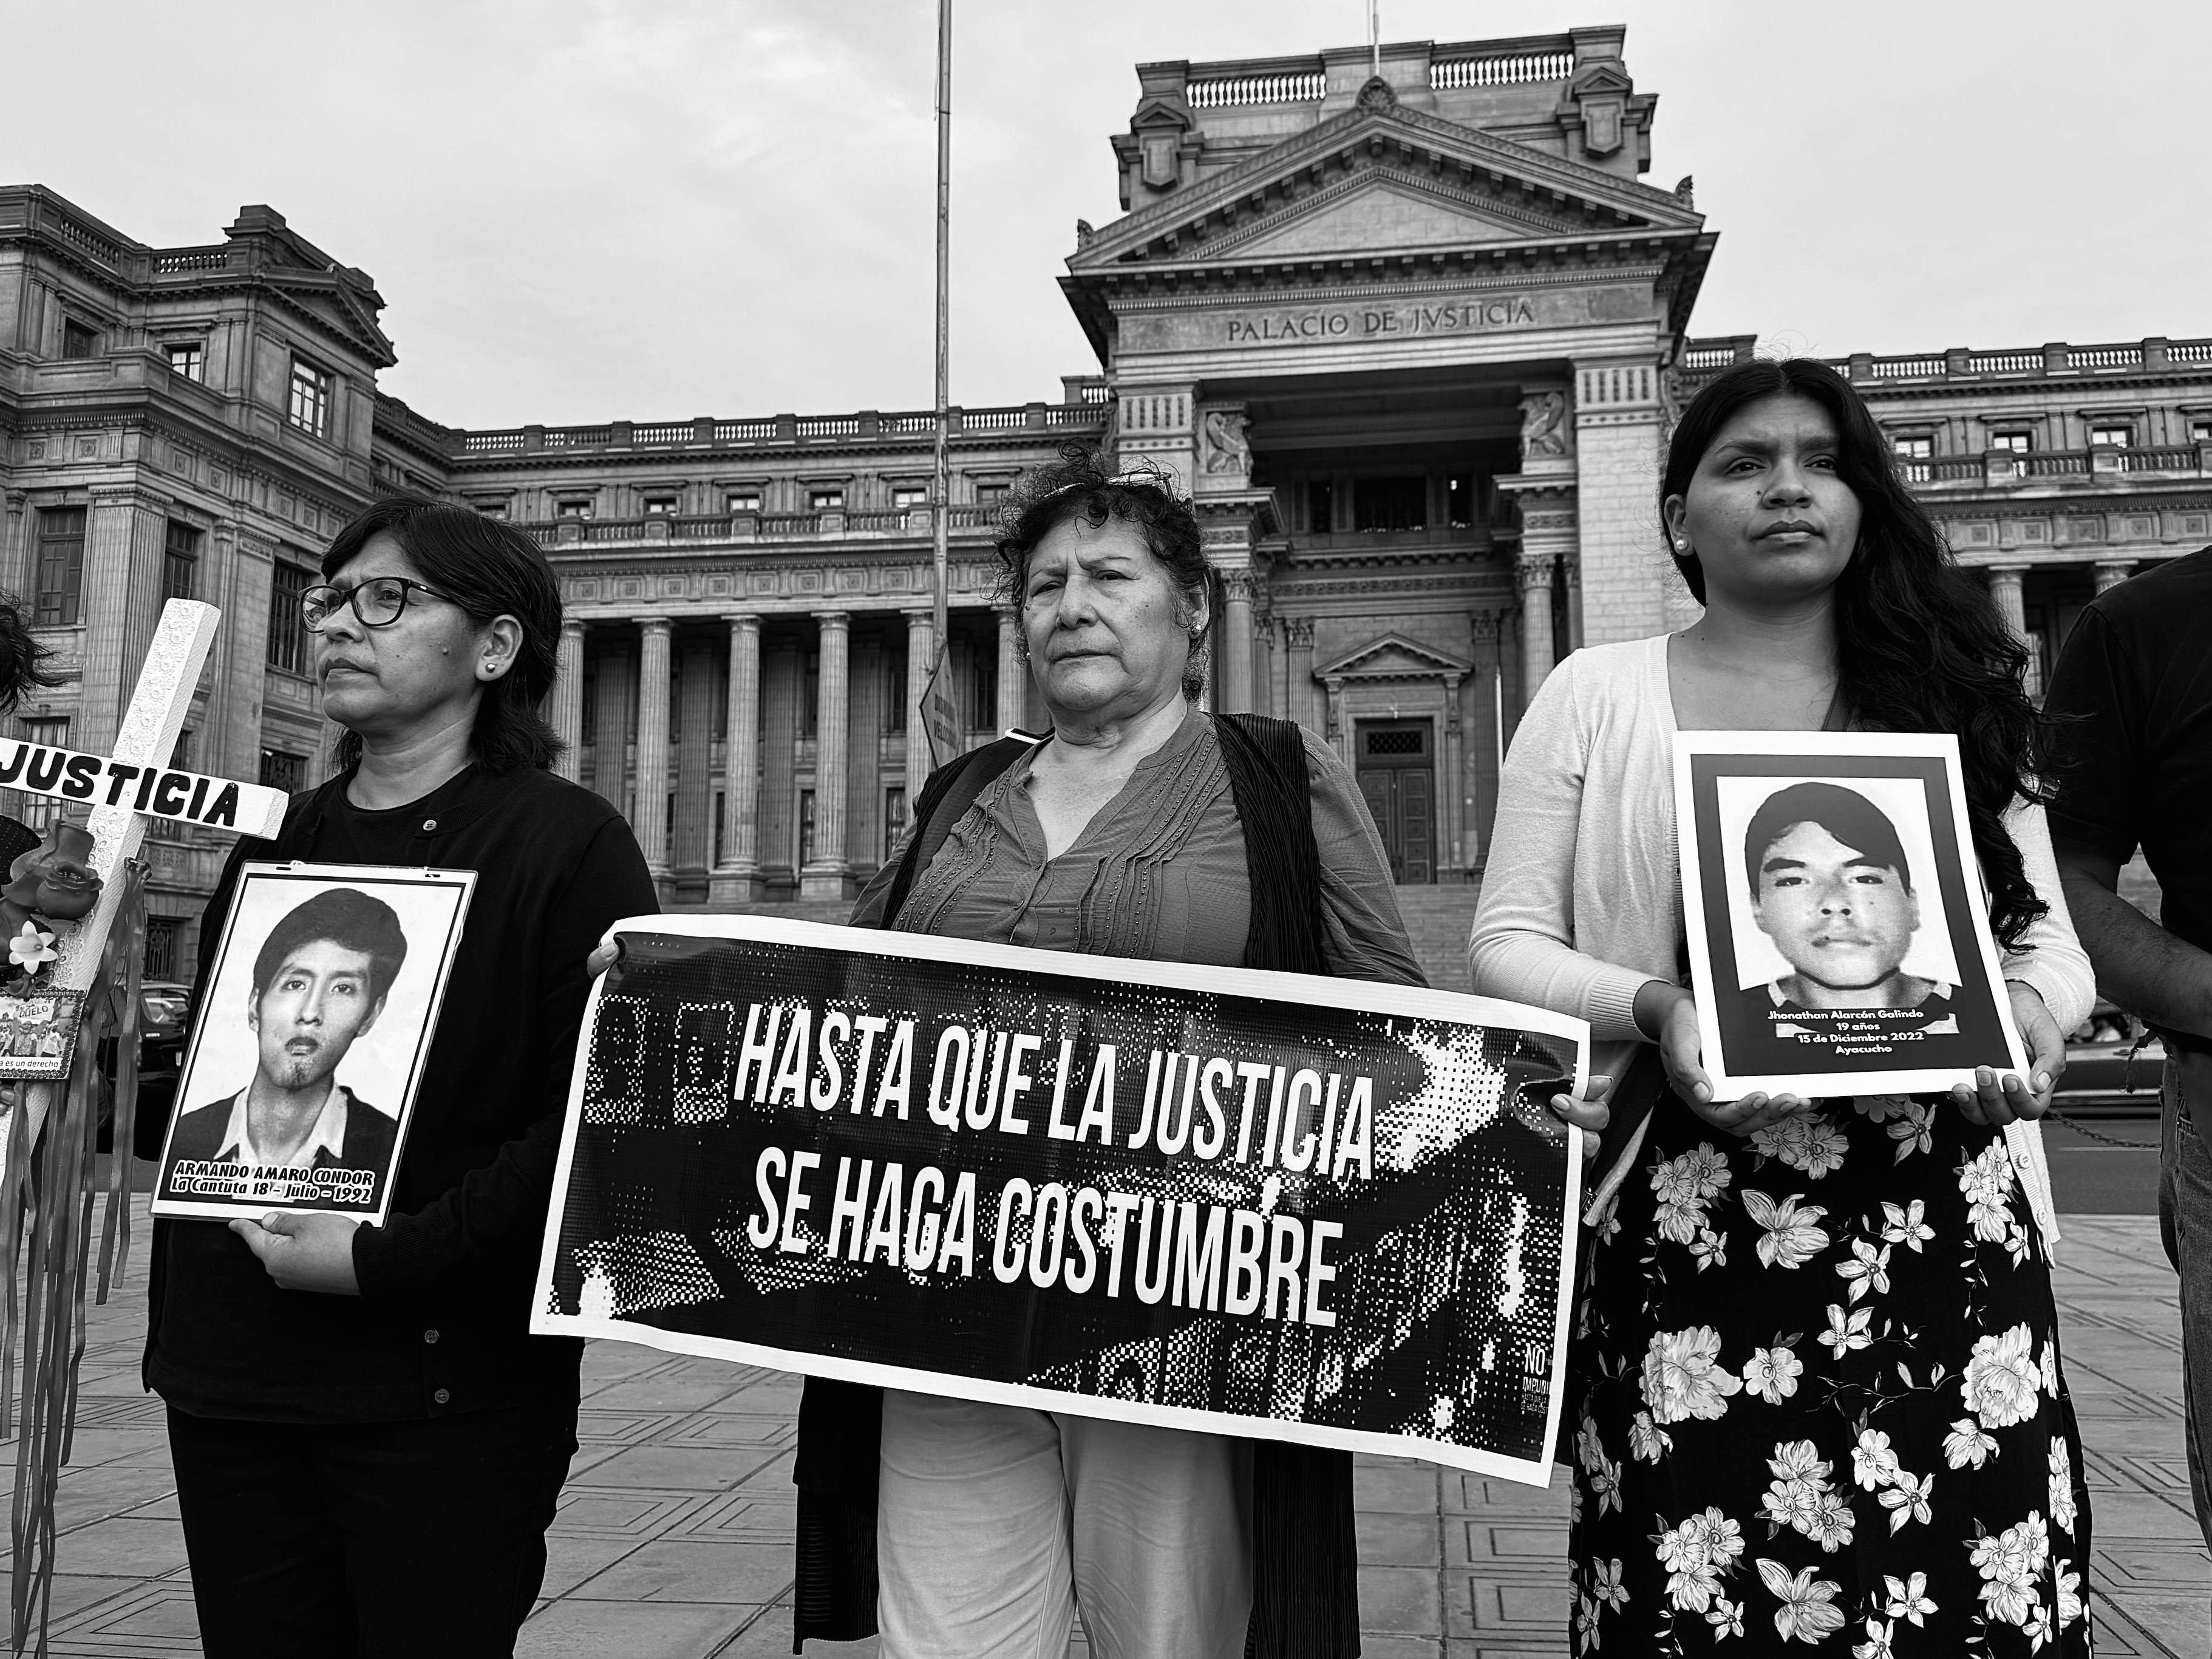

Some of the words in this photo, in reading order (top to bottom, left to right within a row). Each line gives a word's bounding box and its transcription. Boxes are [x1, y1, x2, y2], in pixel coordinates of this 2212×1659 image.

[1228, 313, 1349, 341] PALACIO
[1364, 310, 1398, 333] DE
[1412, 302, 1534, 334] JVSTICIA
[0, 744, 239, 827] JUSTICIA
[1768, 1010, 1829, 1020] Jhonathan
[1831, 1010, 1876, 1020] Alarcón
[1877, 1009, 1924, 1019] Galindo
[1836, 1022, 1850, 1031] 19
[1851, 1021, 1880, 1030] años
[1797, 1035, 1811, 1044] 15
[1812, 1034, 1828, 1043] de
[1829, 1033, 1888, 1043] Diciembre
[1890, 1032, 1925, 1041] 2022
[1835, 1044, 1893, 1056] Ayacucho
[27, 1059, 58, 1068] derecho
[733, 1003, 915, 1120] HASTA
[927, 1024, 1043, 1135] QUE
[1047, 1038, 1117, 1146] LA
[1127, 1049, 1373, 1181] JUSTICIA
[174, 1162, 250, 1179] ARMANDO
[253, 1166, 310, 1182] AMARO
[313, 1169, 374, 1186] CONDOR
[172, 1177, 188, 1191] La
[192, 1179, 247, 1194] Cantuta
[252, 1182, 268, 1196] 18
[284, 1184, 318, 1200] Julio
[335, 1186, 371, 1204] 1992
[747, 1147, 822, 1253] SE
[826, 1156, 976, 1278] HAGA
[992, 1177, 1344, 1327] COSTUMBRE
[1525, 1343, 1546, 1375] NO
[1522, 1376, 1551, 1395] IMPUNI
